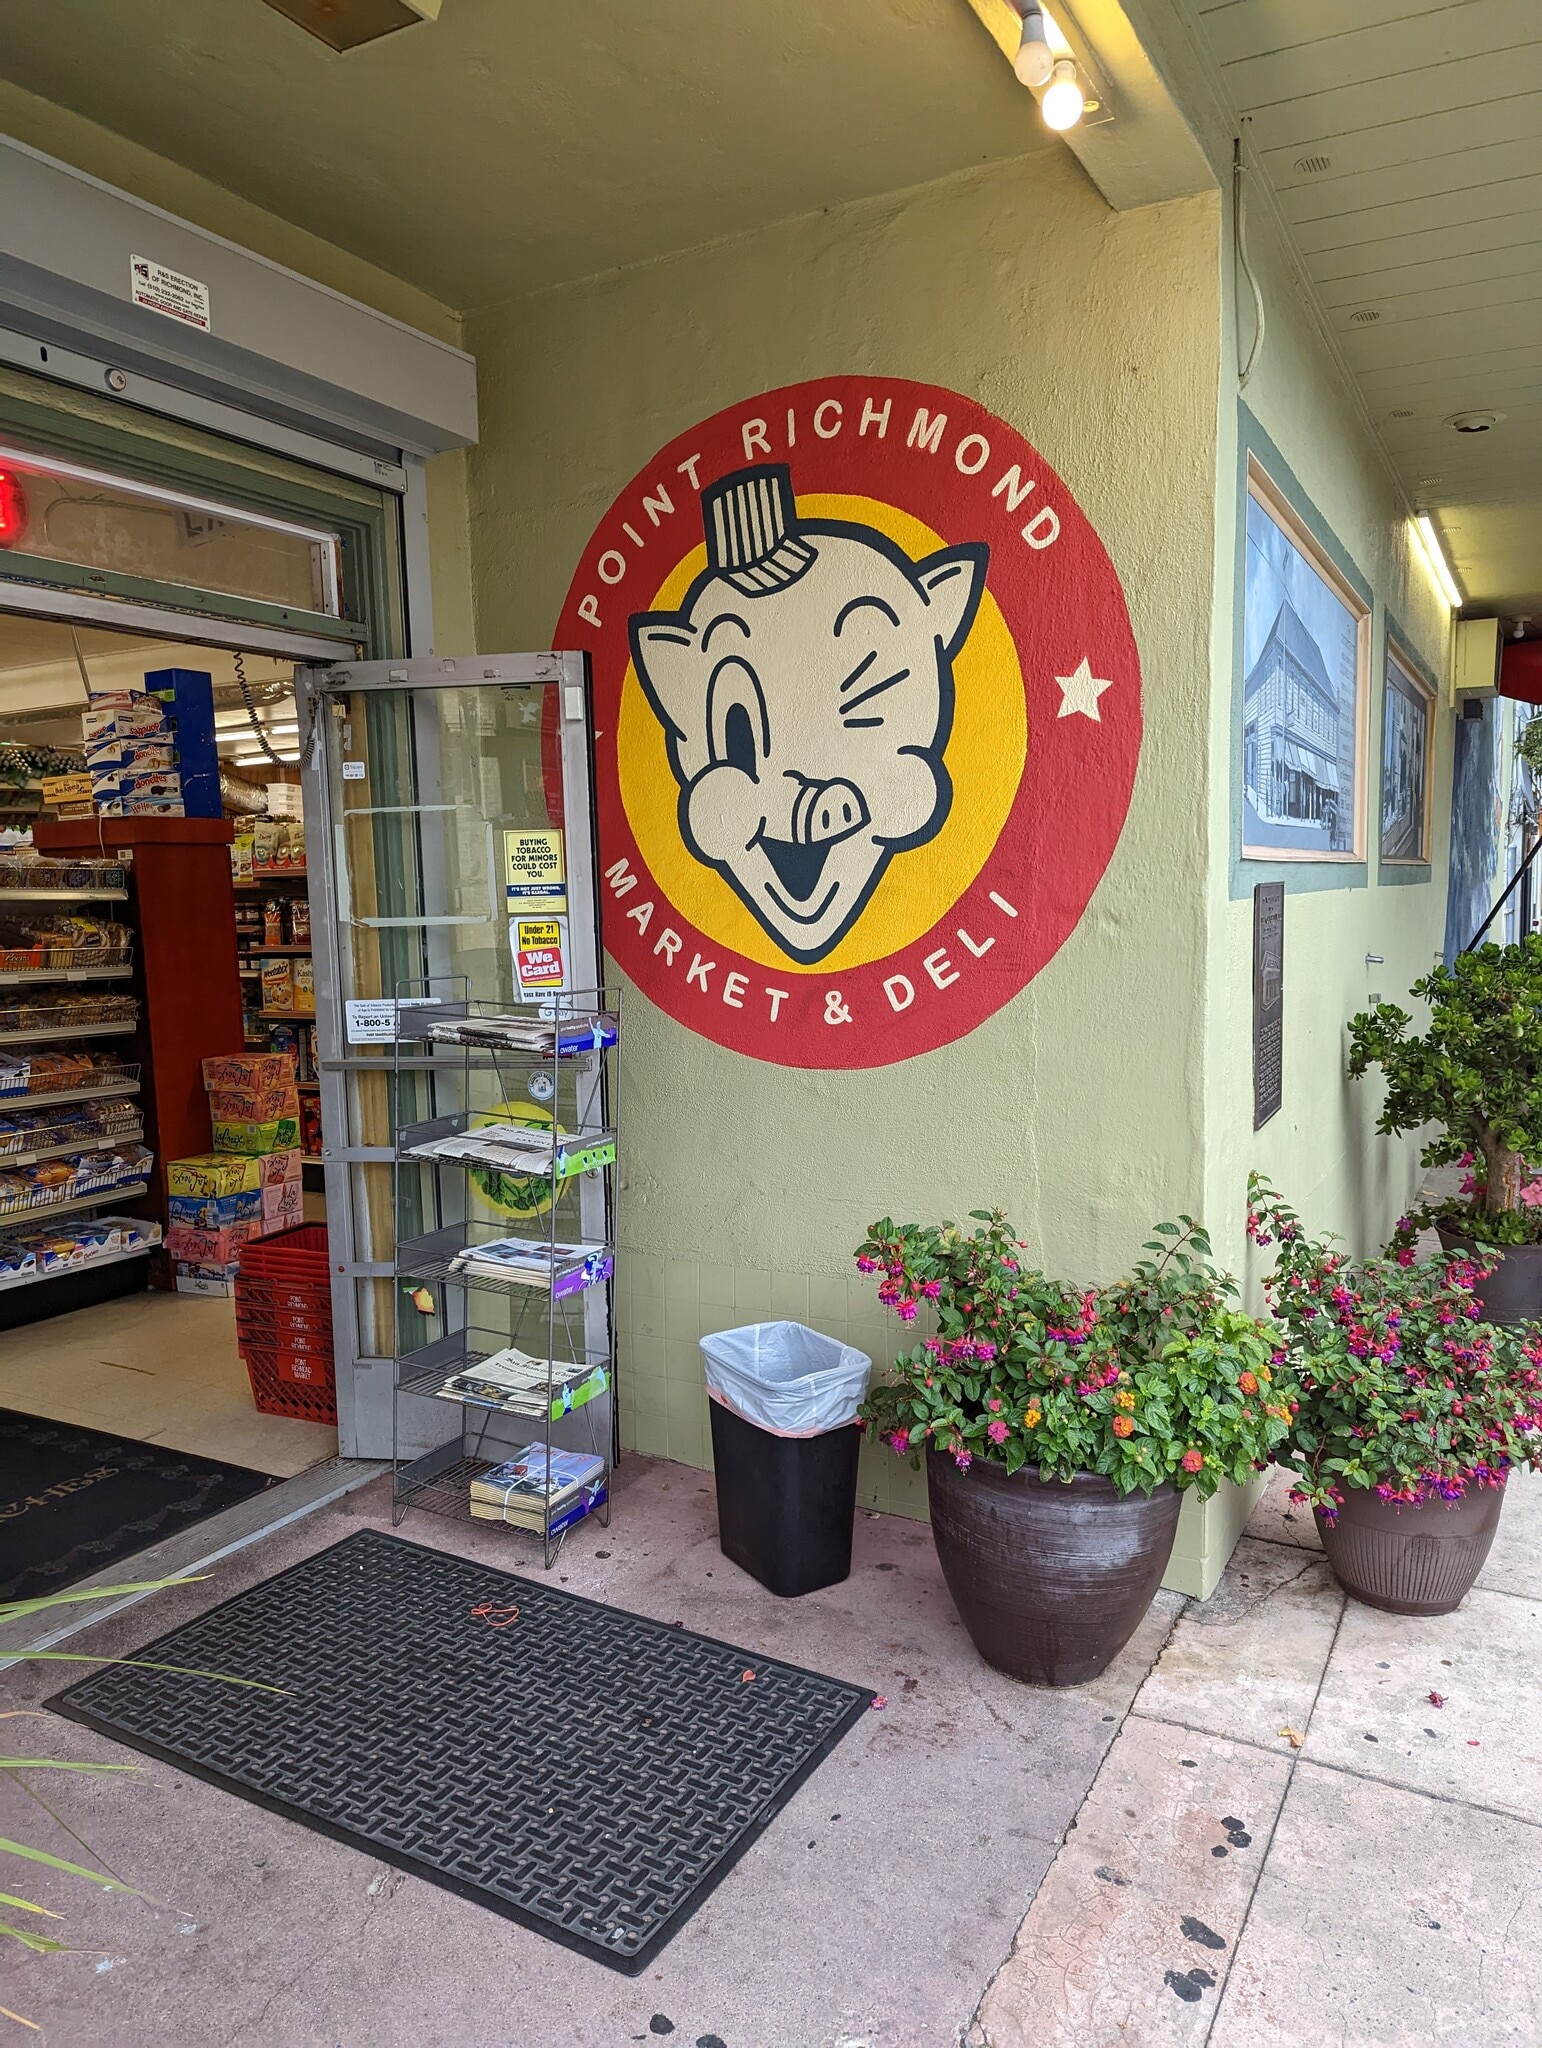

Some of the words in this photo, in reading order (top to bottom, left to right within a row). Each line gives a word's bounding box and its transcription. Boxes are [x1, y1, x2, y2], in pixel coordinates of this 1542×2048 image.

[157, 269, 169, 280] R&S
[170, 275, 199, 291] ERECTION
[147, 282, 161, 294] (510)
[152, 275, 160, 283] OF
[161, 280, 193, 298] RICHMOND,
[193, 292, 203, 301] INC.
[577, 453, 703, 630] POINT
[740, 397, 1062, 551] RICHMOND
[134, 744, 163, 761] donettes
[135, 772, 168, 790] donettes
[519, 838, 547, 847] BUYING
[516, 846, 551, 855] TOBACCO
[511, 855, 527, 863] FOR
[528, 853, 558, 862] MINORS
[512, 862, 537, 871] COULD
[539, 861, 557, 870] COST
[527, 870, 545, 878] YOU.
[524, 925, 544, 935] Under
[546, 925, 554, 934] 21
[521, 936, 531, 945] No
[532, 935, 558, 945] Tobacco
[604, 857, 790, 1024] MARKET
[823, 990, 853, 1025] &
[884, 890, 1019, 1014] DELI
[525, 951, 554, 965] We
[521, 960, 561, 978] Card
[355, 1019, 391, 1027] 1-800-5
[294, 1358, 307, 1366] POINT
[291, 1364, 312, 1374] RICHMOND
[294, 1371, 311, 1380] MARKET
